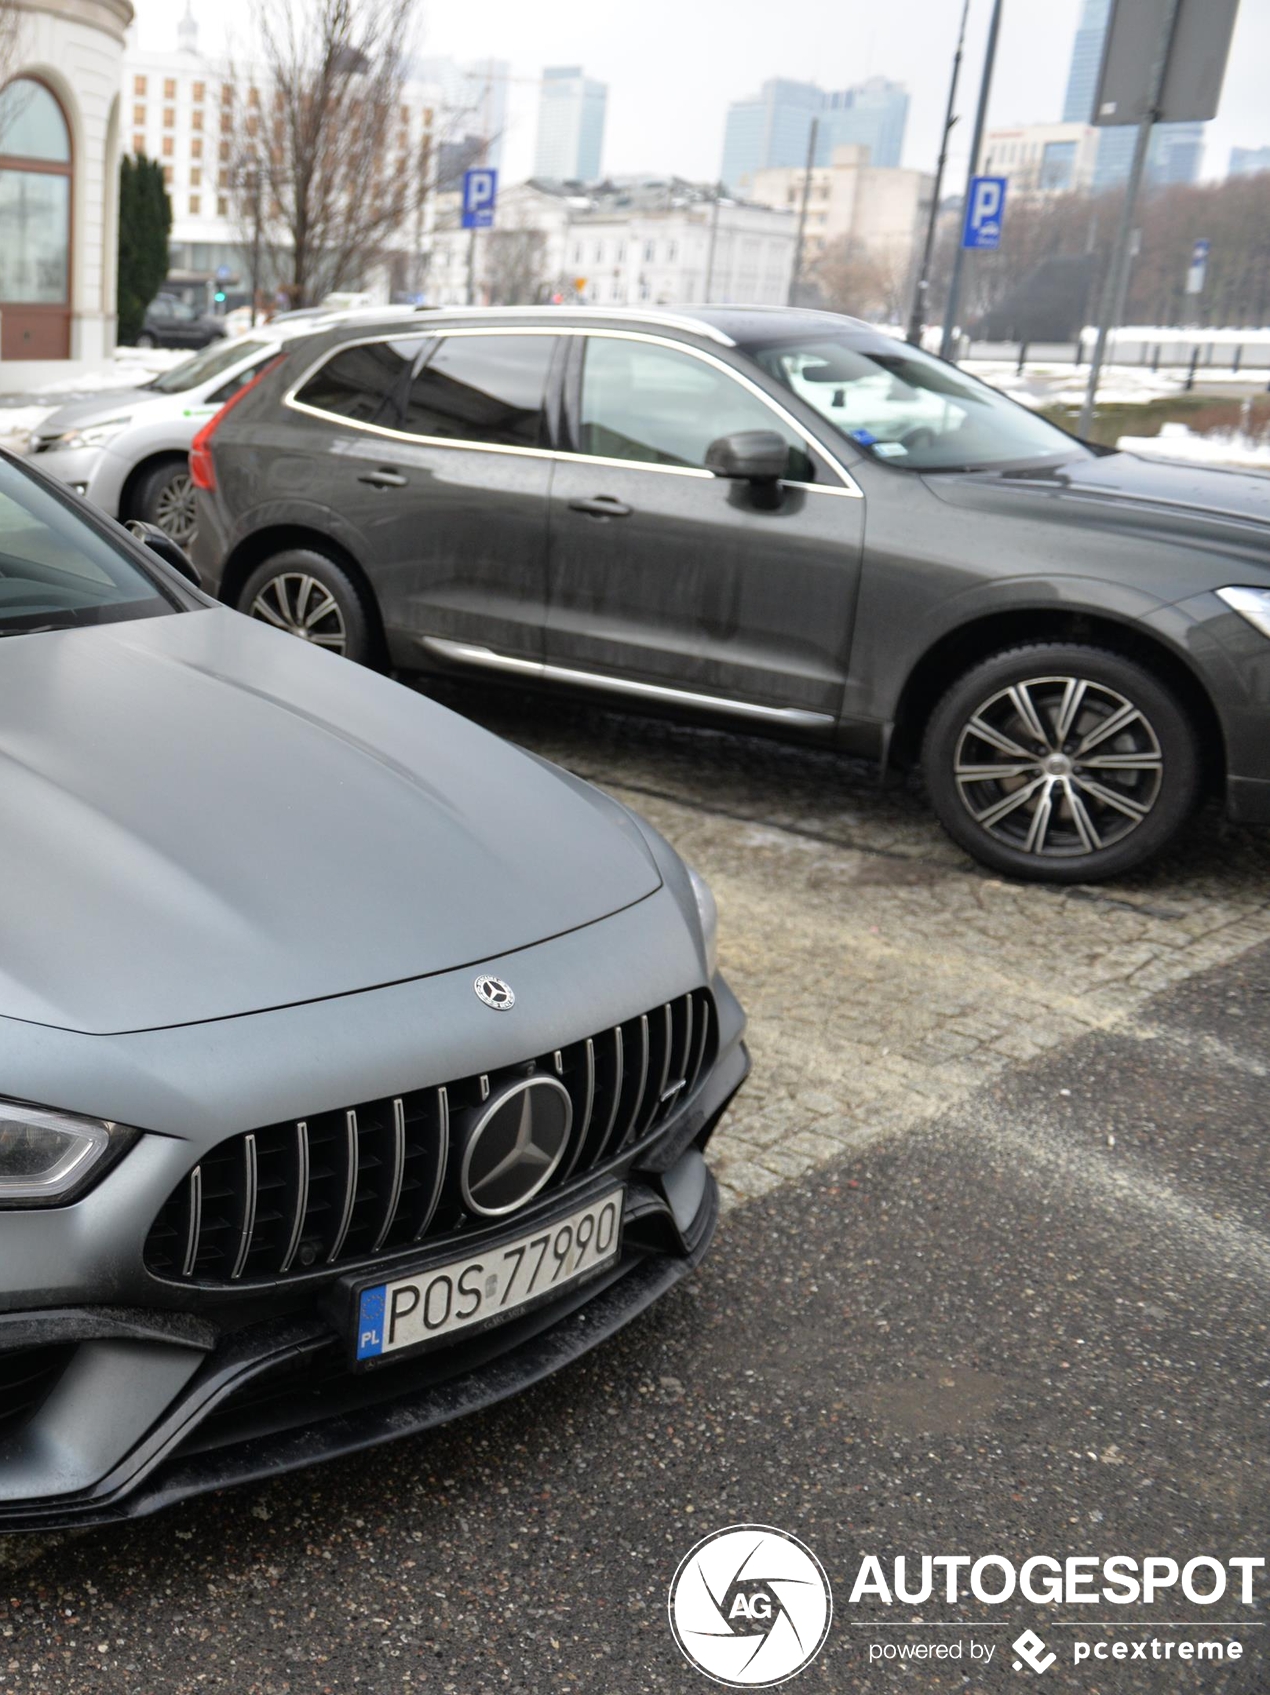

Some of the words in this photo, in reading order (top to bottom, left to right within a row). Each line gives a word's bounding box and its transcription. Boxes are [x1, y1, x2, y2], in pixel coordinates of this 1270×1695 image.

[468, 173, 492, 211] P
[971, 181, 1001, 228] P
[389, 1264, 484, 1344] POS
[499, 1202, 616, 1306] 77990
[361, 1330, 380, 1348] PL
